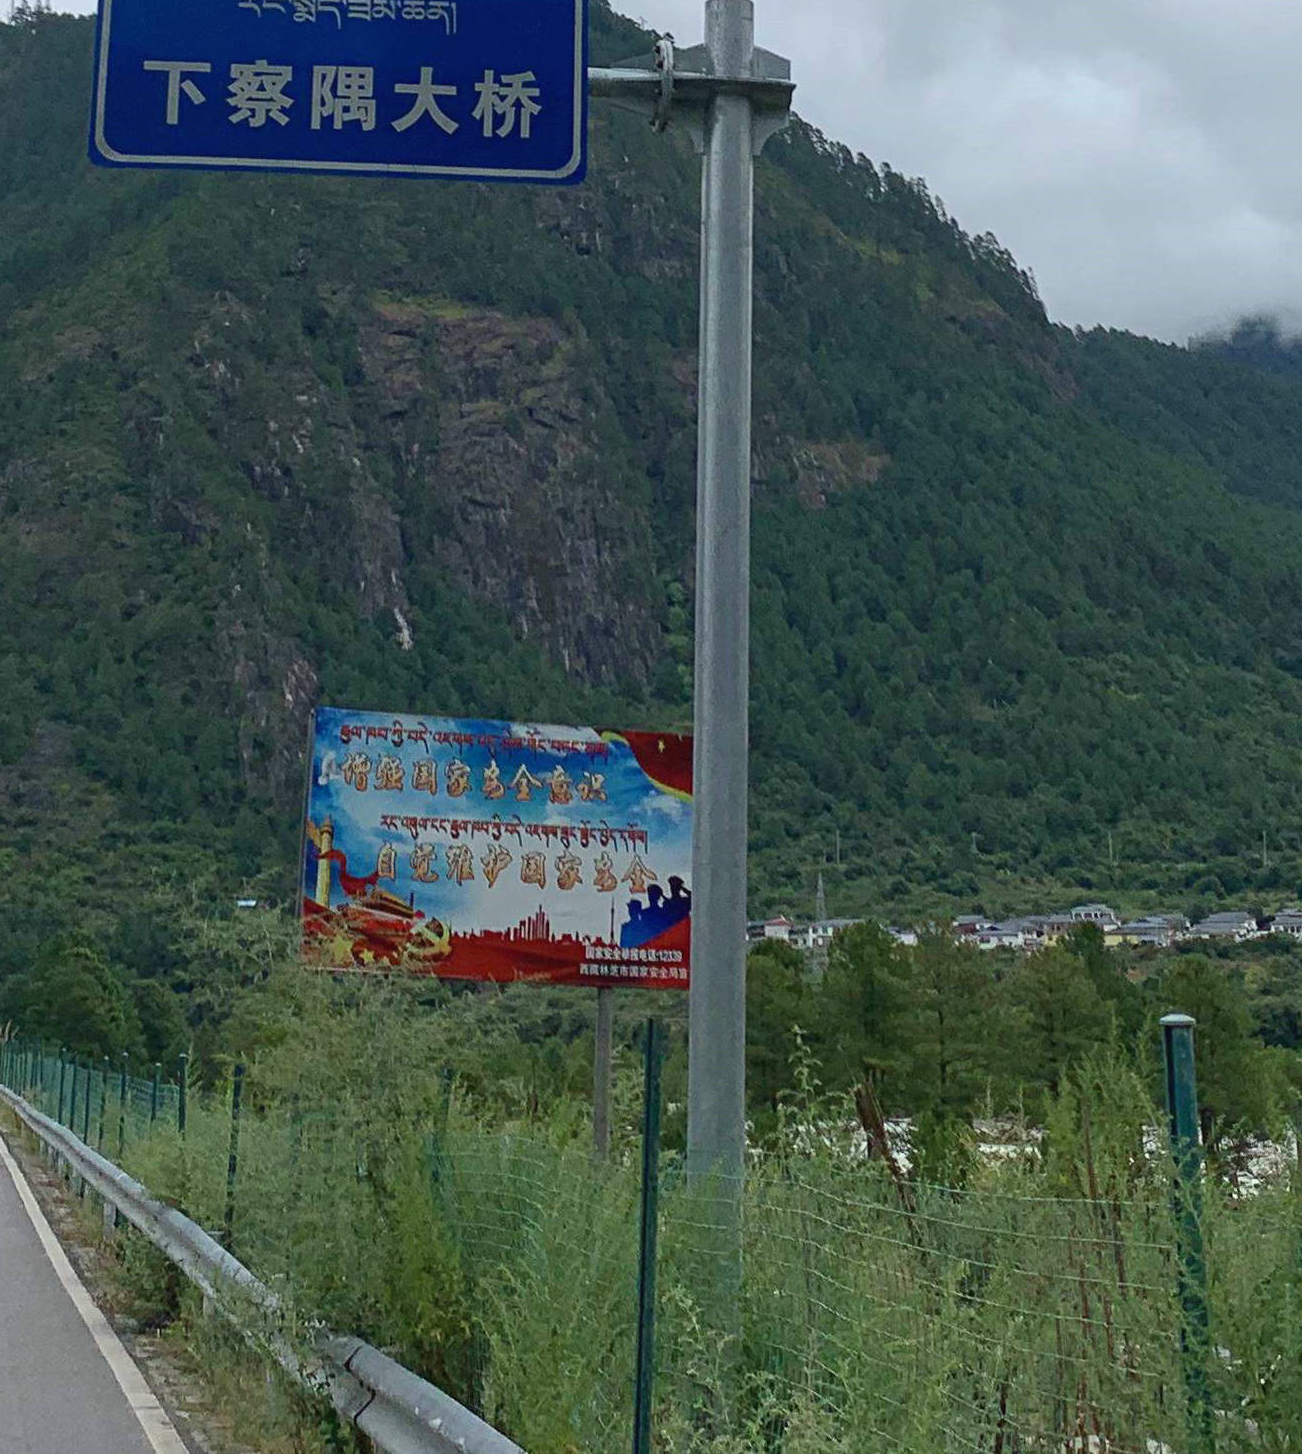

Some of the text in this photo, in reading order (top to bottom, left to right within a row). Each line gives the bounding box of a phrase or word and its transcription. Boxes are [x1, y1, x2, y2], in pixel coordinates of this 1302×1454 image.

[143, 59, 543, 139] 下察隅大桥
[340, 752, 608, 805] 增强国家安全意识
[377, 839, 658, 894] 自觉维护国家安全
